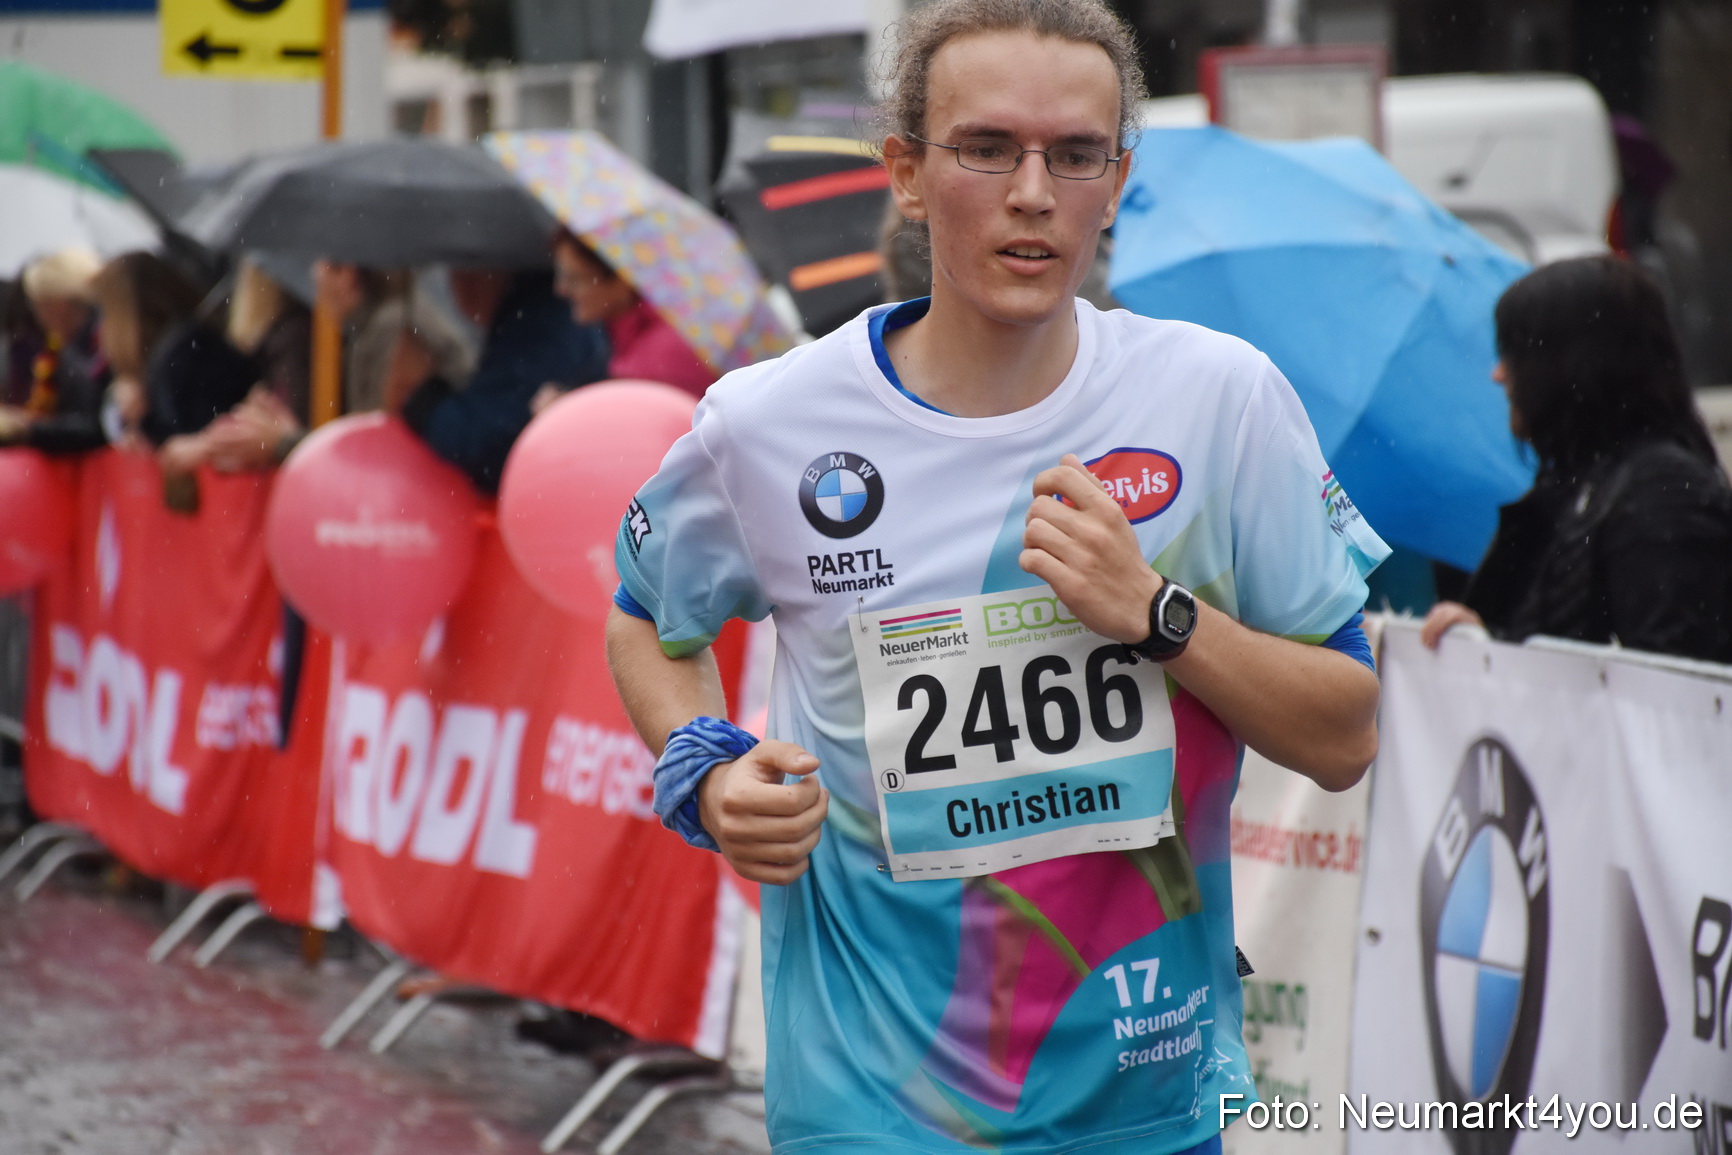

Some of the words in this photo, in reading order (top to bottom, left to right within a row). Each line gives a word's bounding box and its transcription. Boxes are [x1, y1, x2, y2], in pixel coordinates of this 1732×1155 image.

[804, 453, 877, 485] BMW
[1090, 467, 1170, 504] ervis
[807, 548, 894, 577] PARTL
[811, 571, 895, 595] Neumarkt
[879, 631, 969, 658] NeuerMarkt
[987, 633, 1031, 648] inspired
[1034, 632, 1047, 642] by
[1050, 626, 1082, 639] smart
[897, 643, 1144, 775] 2466
[946, 782, 1121, 838] Christian
[1434, 743, 1549, 902] BMW
[1103, 957, 1172, 1008] 17.
